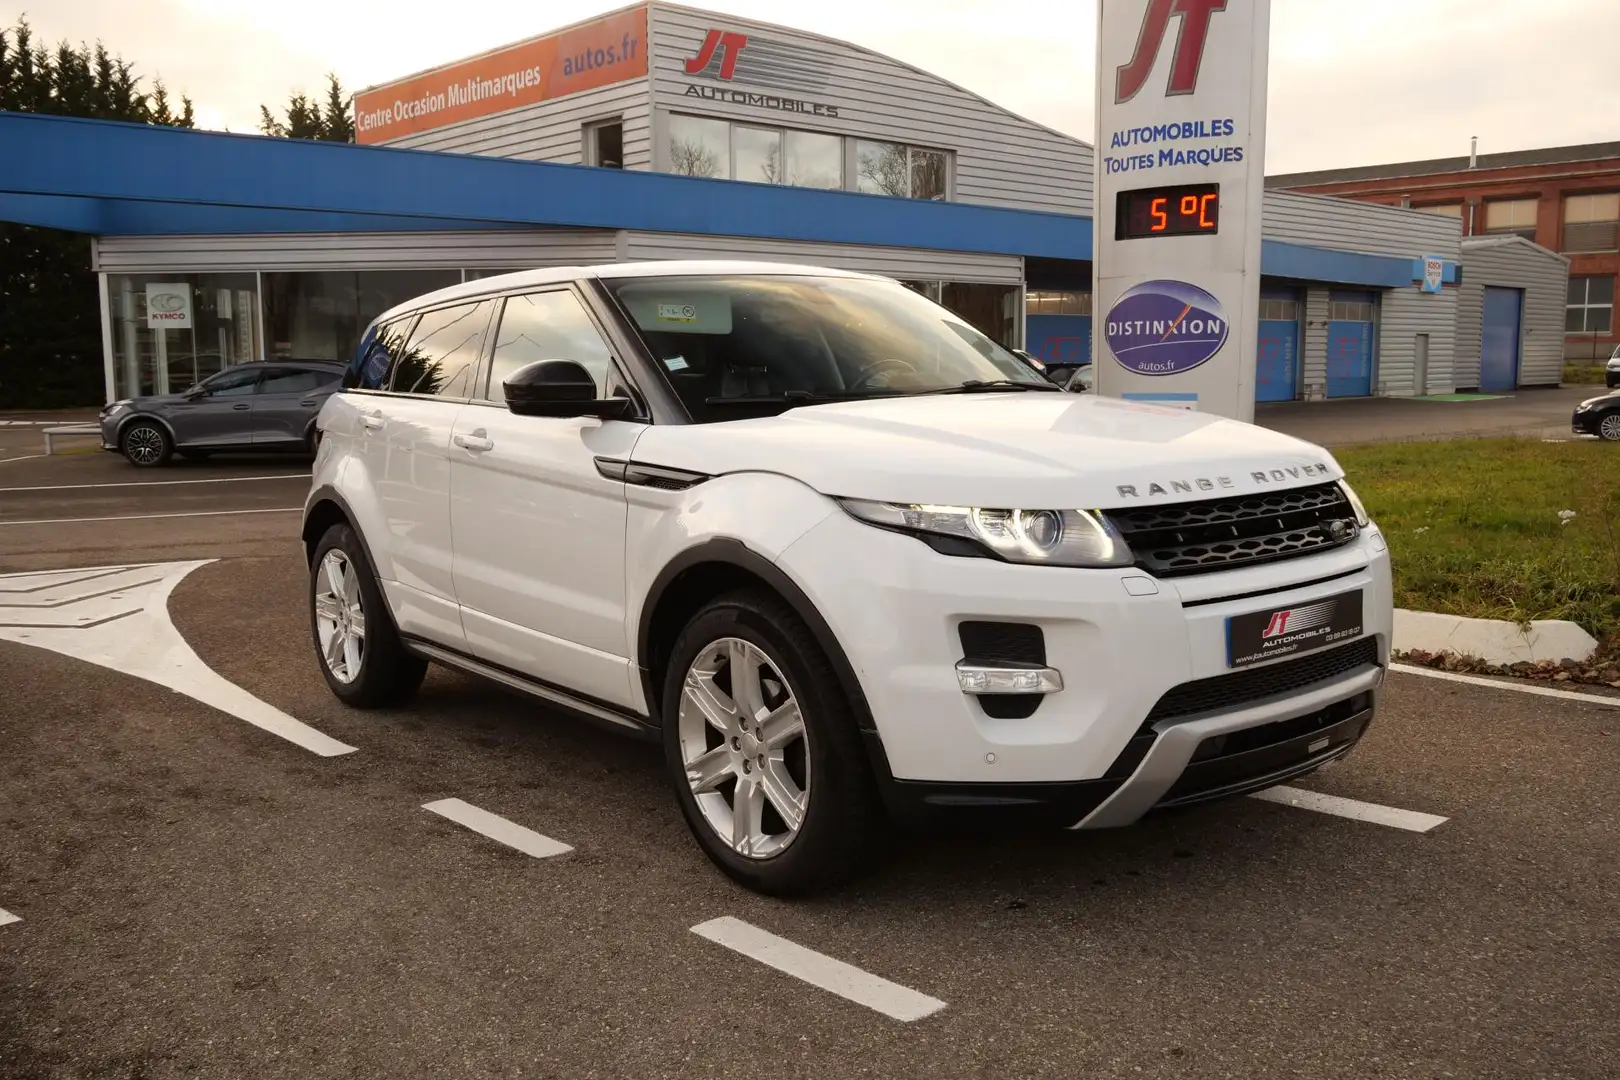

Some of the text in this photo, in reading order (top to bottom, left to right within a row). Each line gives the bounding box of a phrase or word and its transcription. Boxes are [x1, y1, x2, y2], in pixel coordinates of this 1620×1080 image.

[563, 32, 639, 77] autos.fr
[683, 28, 748, 82] JT
[357, 66, 541, 132] Centre Occasion Multimarques
[684, 84, 839, 118] AUTOMOBILES
[1110, 119, 1234, 149] AUTOMOBILES
[1151, 197, 1167, 230] 5
[151, 312, 186, 321] KYMCO
[1108, 319, 1221, 337] DISTINXION
[1137, 360, 1176, 372] autos.fr
[1115, 462, 1330, 499] RANGE ROVER
[1262, 610, 1292, 639] JT
[1262, 626, 1331, 648] AUTOMOBILES
